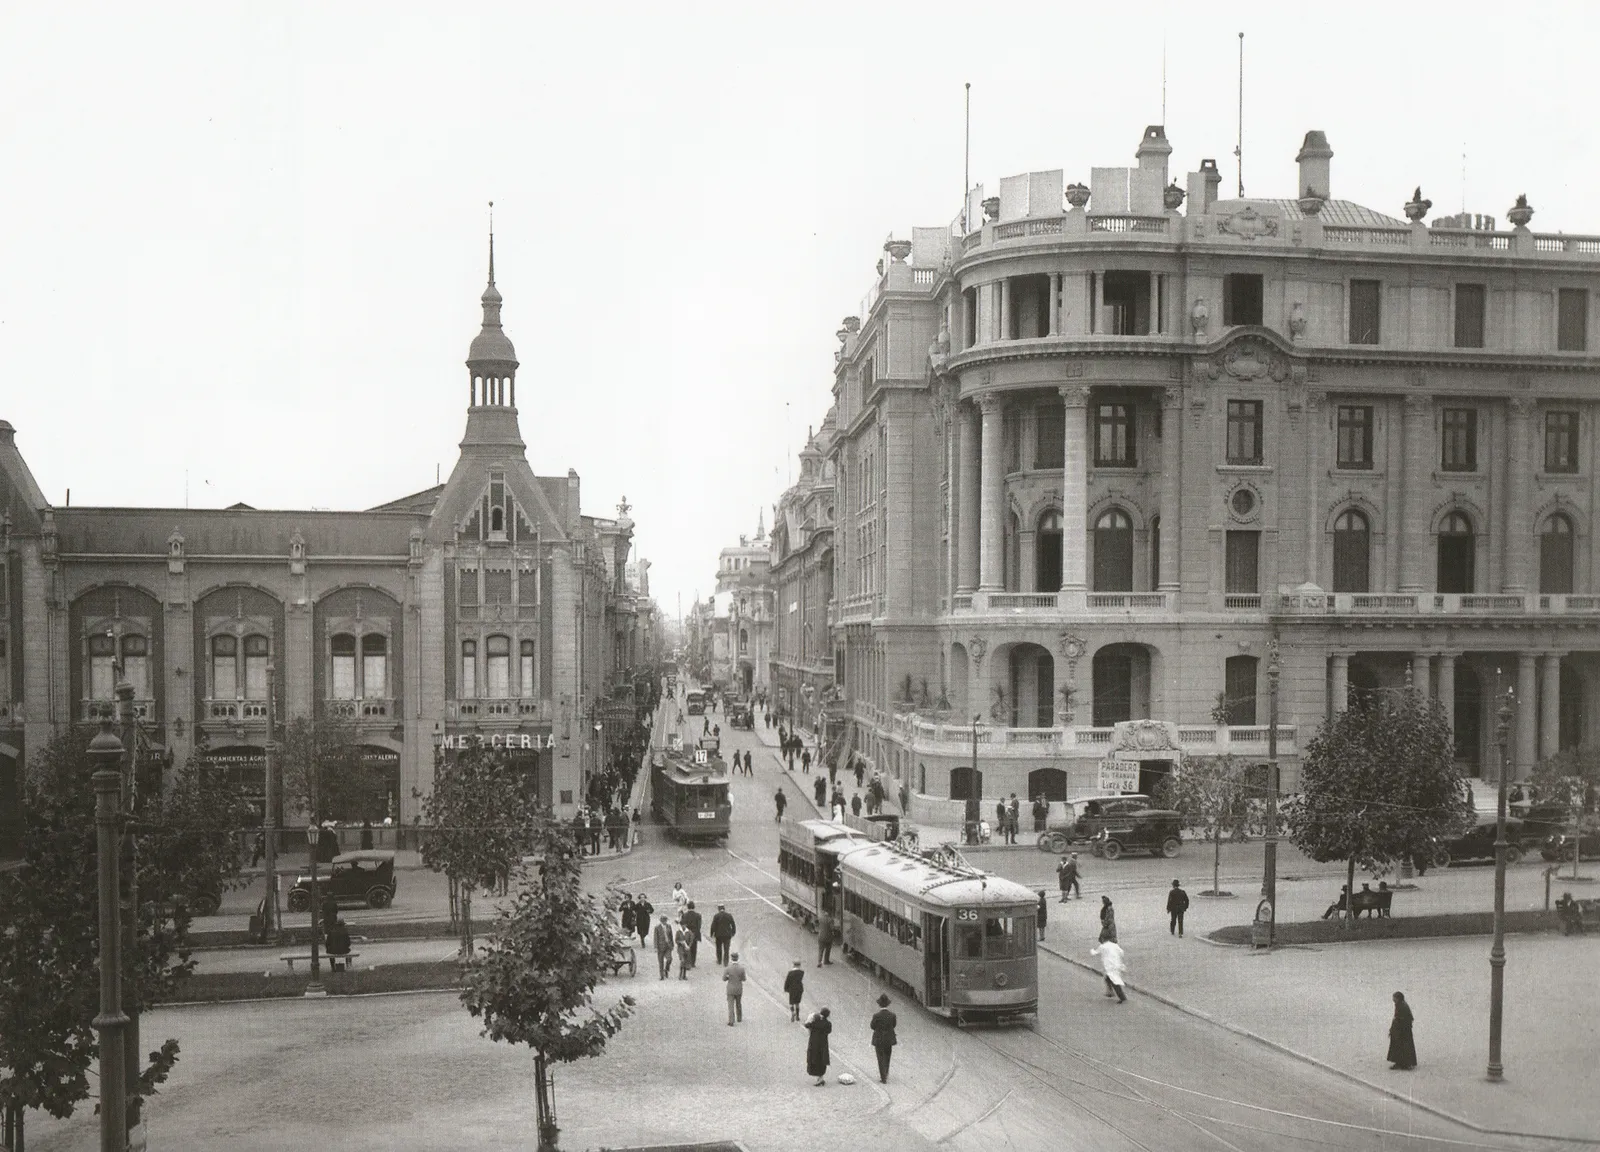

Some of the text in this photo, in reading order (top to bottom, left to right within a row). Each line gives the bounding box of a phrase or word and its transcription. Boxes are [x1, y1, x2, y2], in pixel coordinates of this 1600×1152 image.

[697, 751, 706, 763] 17
[1101, 762, 1137, 772] PARADERO
[1122, 781, 1133, 790] 36
[959, 909, 978, 920] 36
